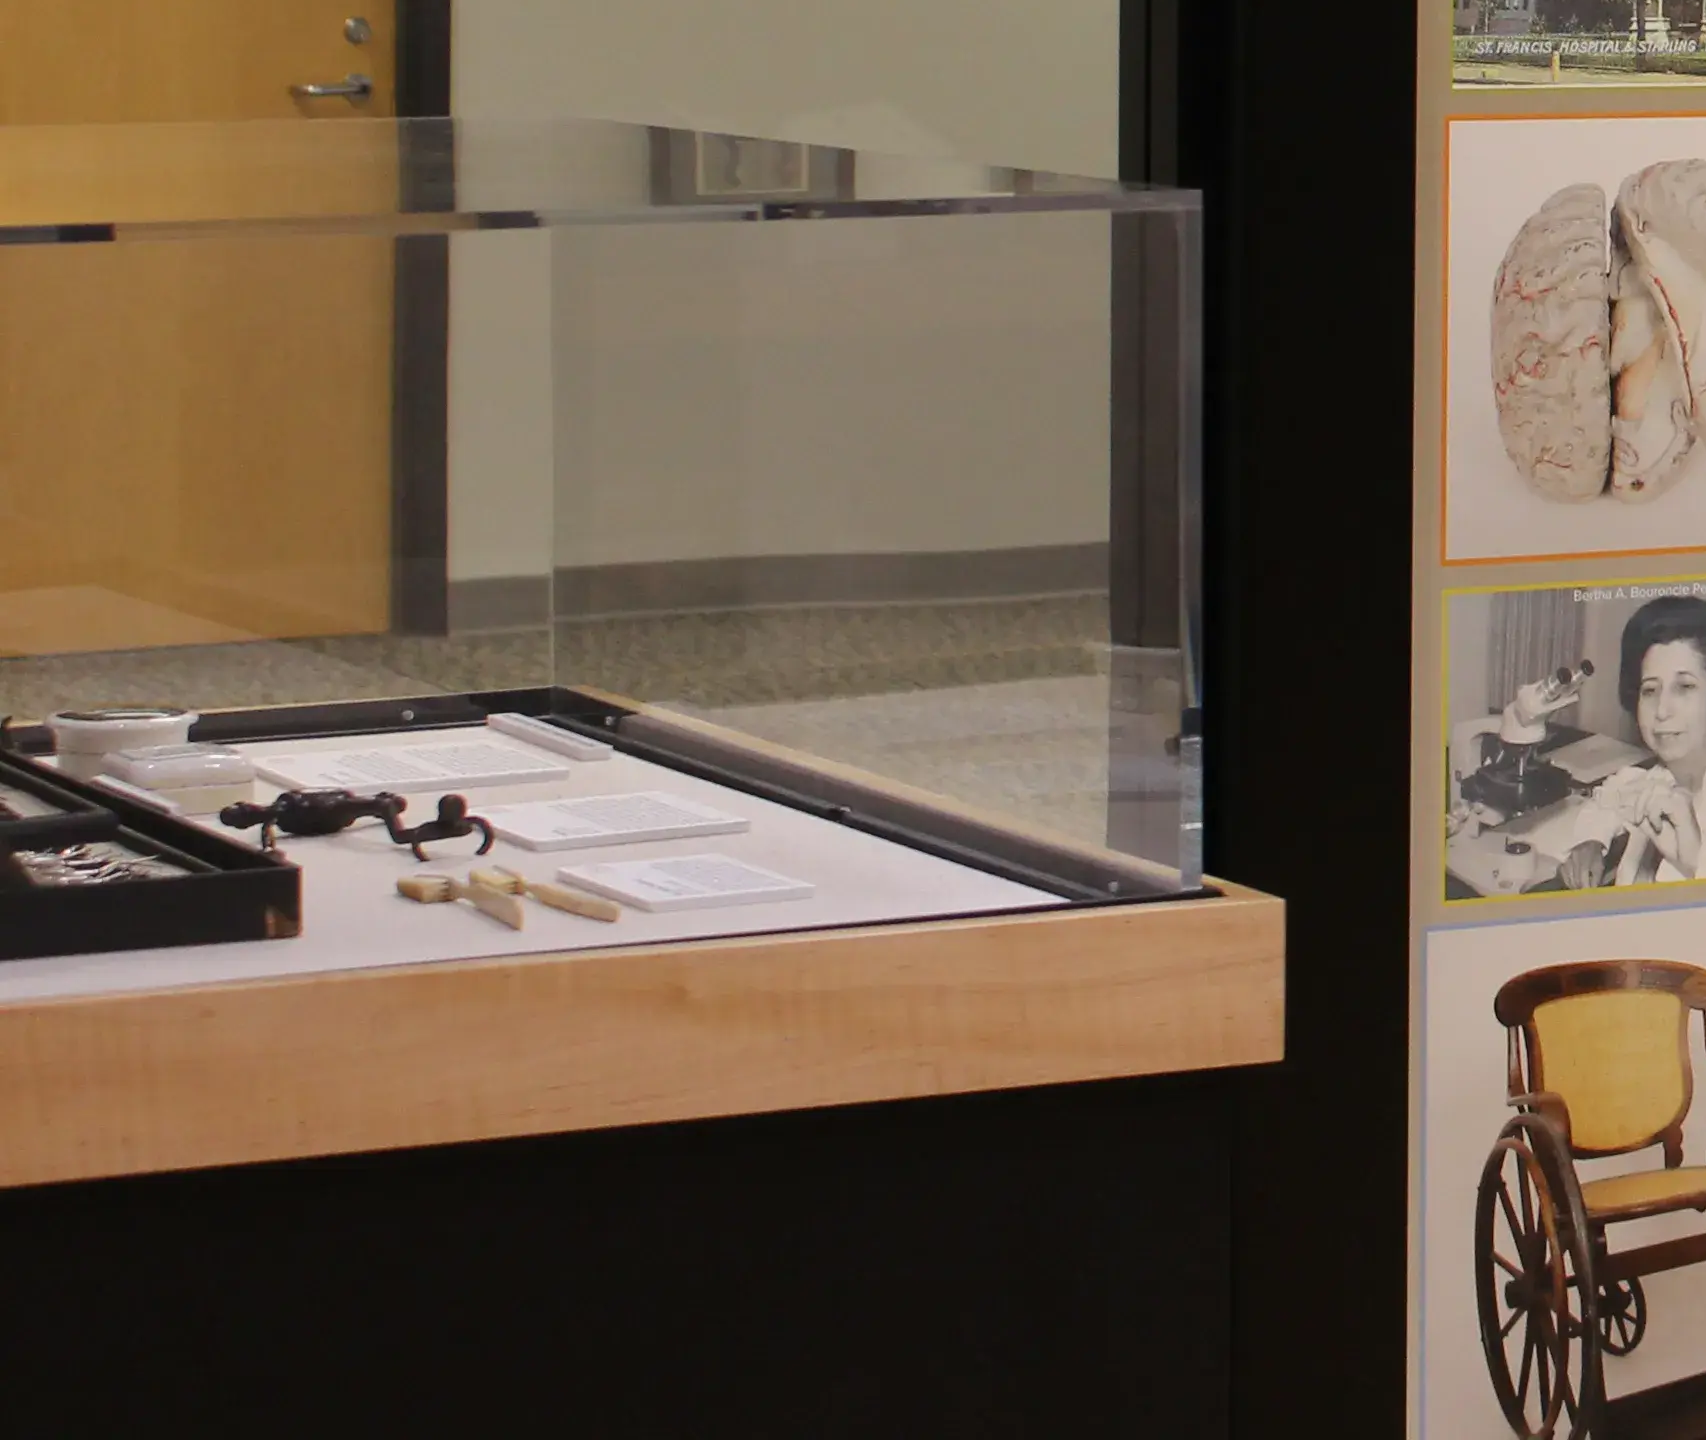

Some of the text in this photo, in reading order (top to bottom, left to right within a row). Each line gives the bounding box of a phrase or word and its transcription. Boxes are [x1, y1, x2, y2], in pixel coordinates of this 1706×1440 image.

[1475, 41, 1493, 54] ST.
[1496, 40, 1553, 54] FRANCIS
[1559, 40, 1621, 54] HOSPITAL
[1624, 41, 1636, 54] &
[1636, 40, 1698, 54] STARLING
[1573, 588, 1613, 602] Bertha
[1615, 587, 1628, 600] A.
[1630, 584, 1690, 599] Bouroncle
